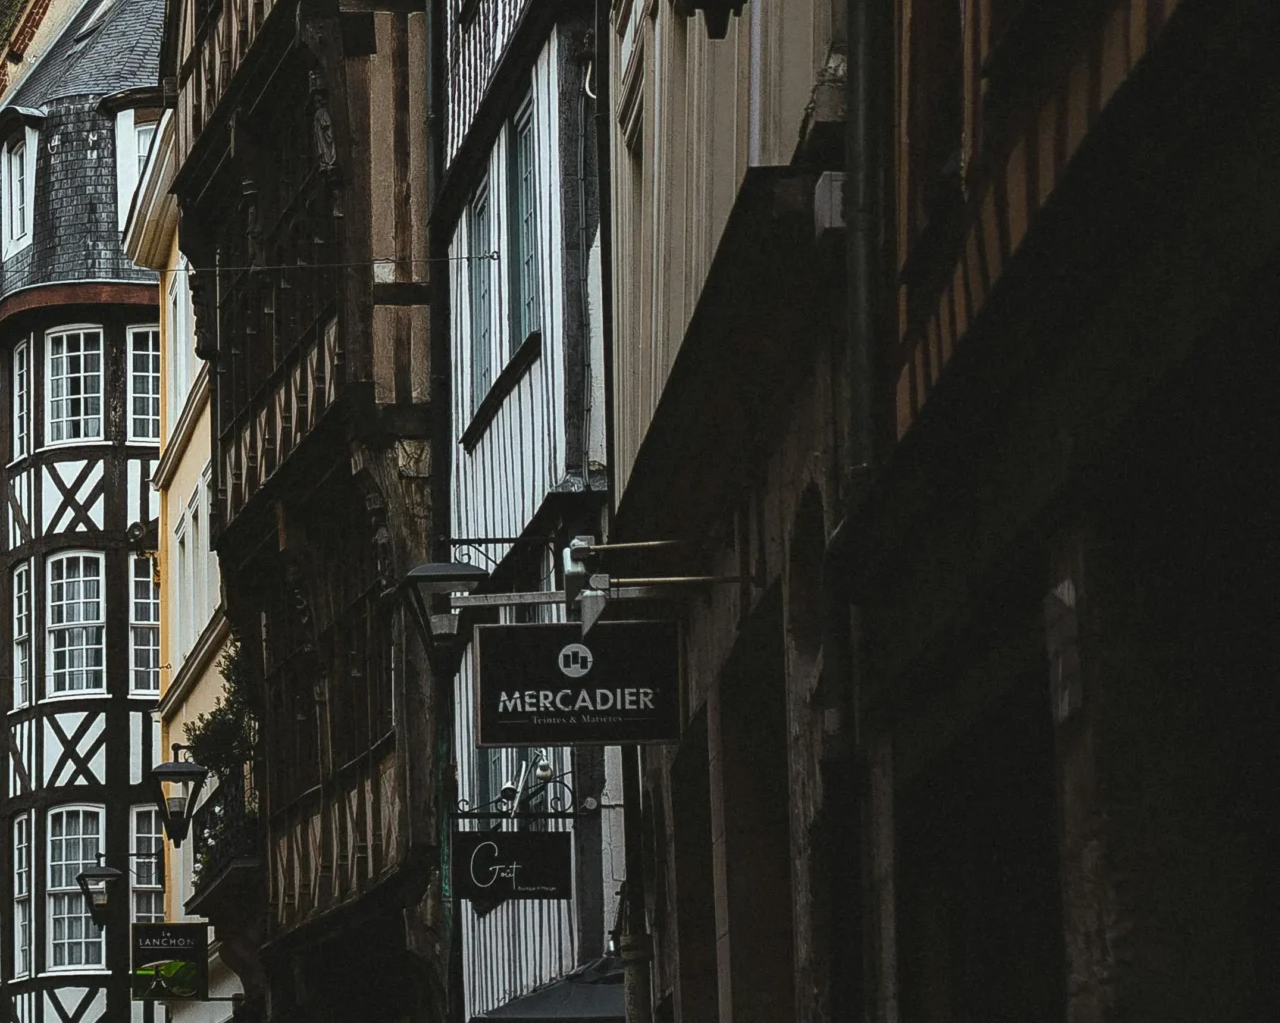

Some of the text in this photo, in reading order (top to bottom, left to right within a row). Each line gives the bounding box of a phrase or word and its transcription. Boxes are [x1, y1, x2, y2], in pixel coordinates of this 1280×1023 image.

[498, 688, 653, 712] MERCADIER
[532, 715, 566, 725] Teintes
[569, 715, 577, 724] &
[139, 938, 194, 946] LANCHON
